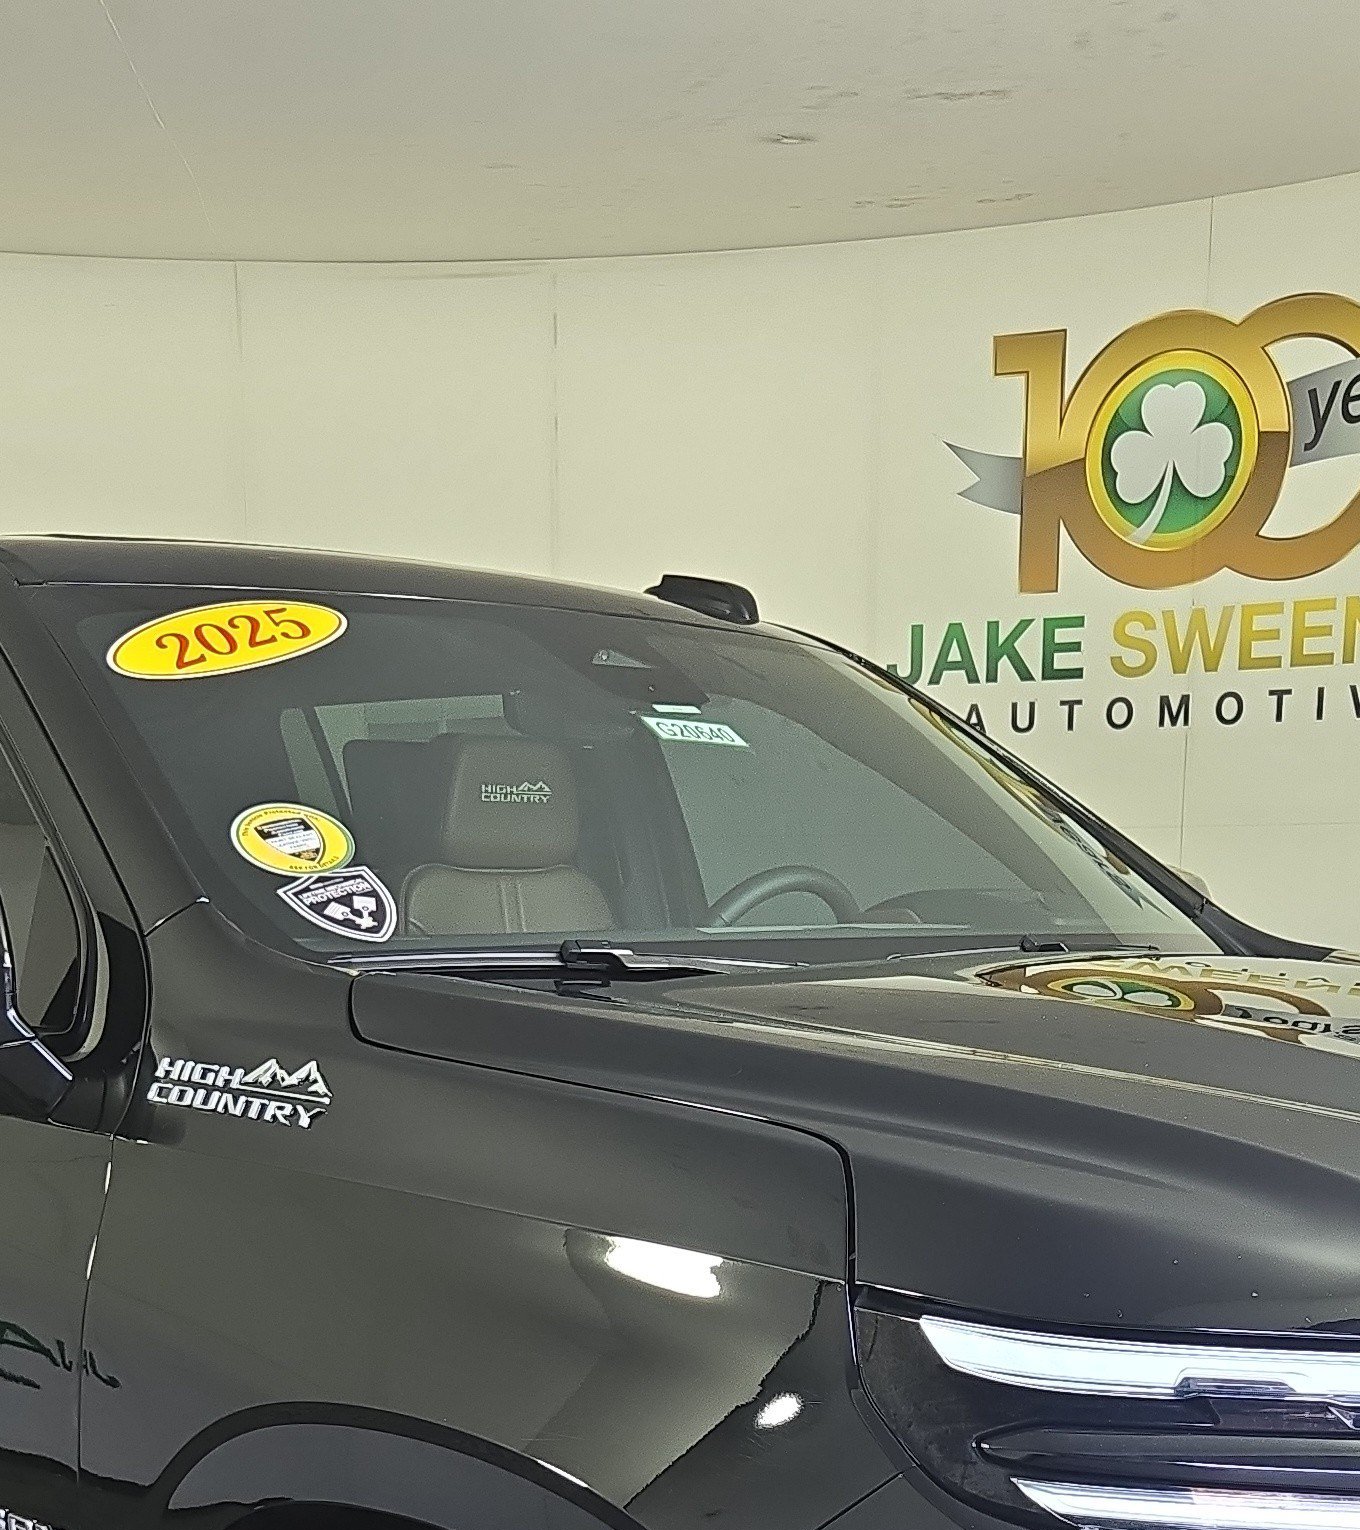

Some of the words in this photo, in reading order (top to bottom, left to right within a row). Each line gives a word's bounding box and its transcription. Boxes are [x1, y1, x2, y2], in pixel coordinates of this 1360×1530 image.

[155, 608, 313, 671] 2025
[886, 614, 1086, 686] JAKE
[481, 784, 517, 794] HIGH
[481, 793, 551, 804] COUNTRY
[301, 880, 374, 906] PROTECTION
[154, 1056, 245, 1089] HIGH
[146, 1082, 329, 1130] COUNTRY
